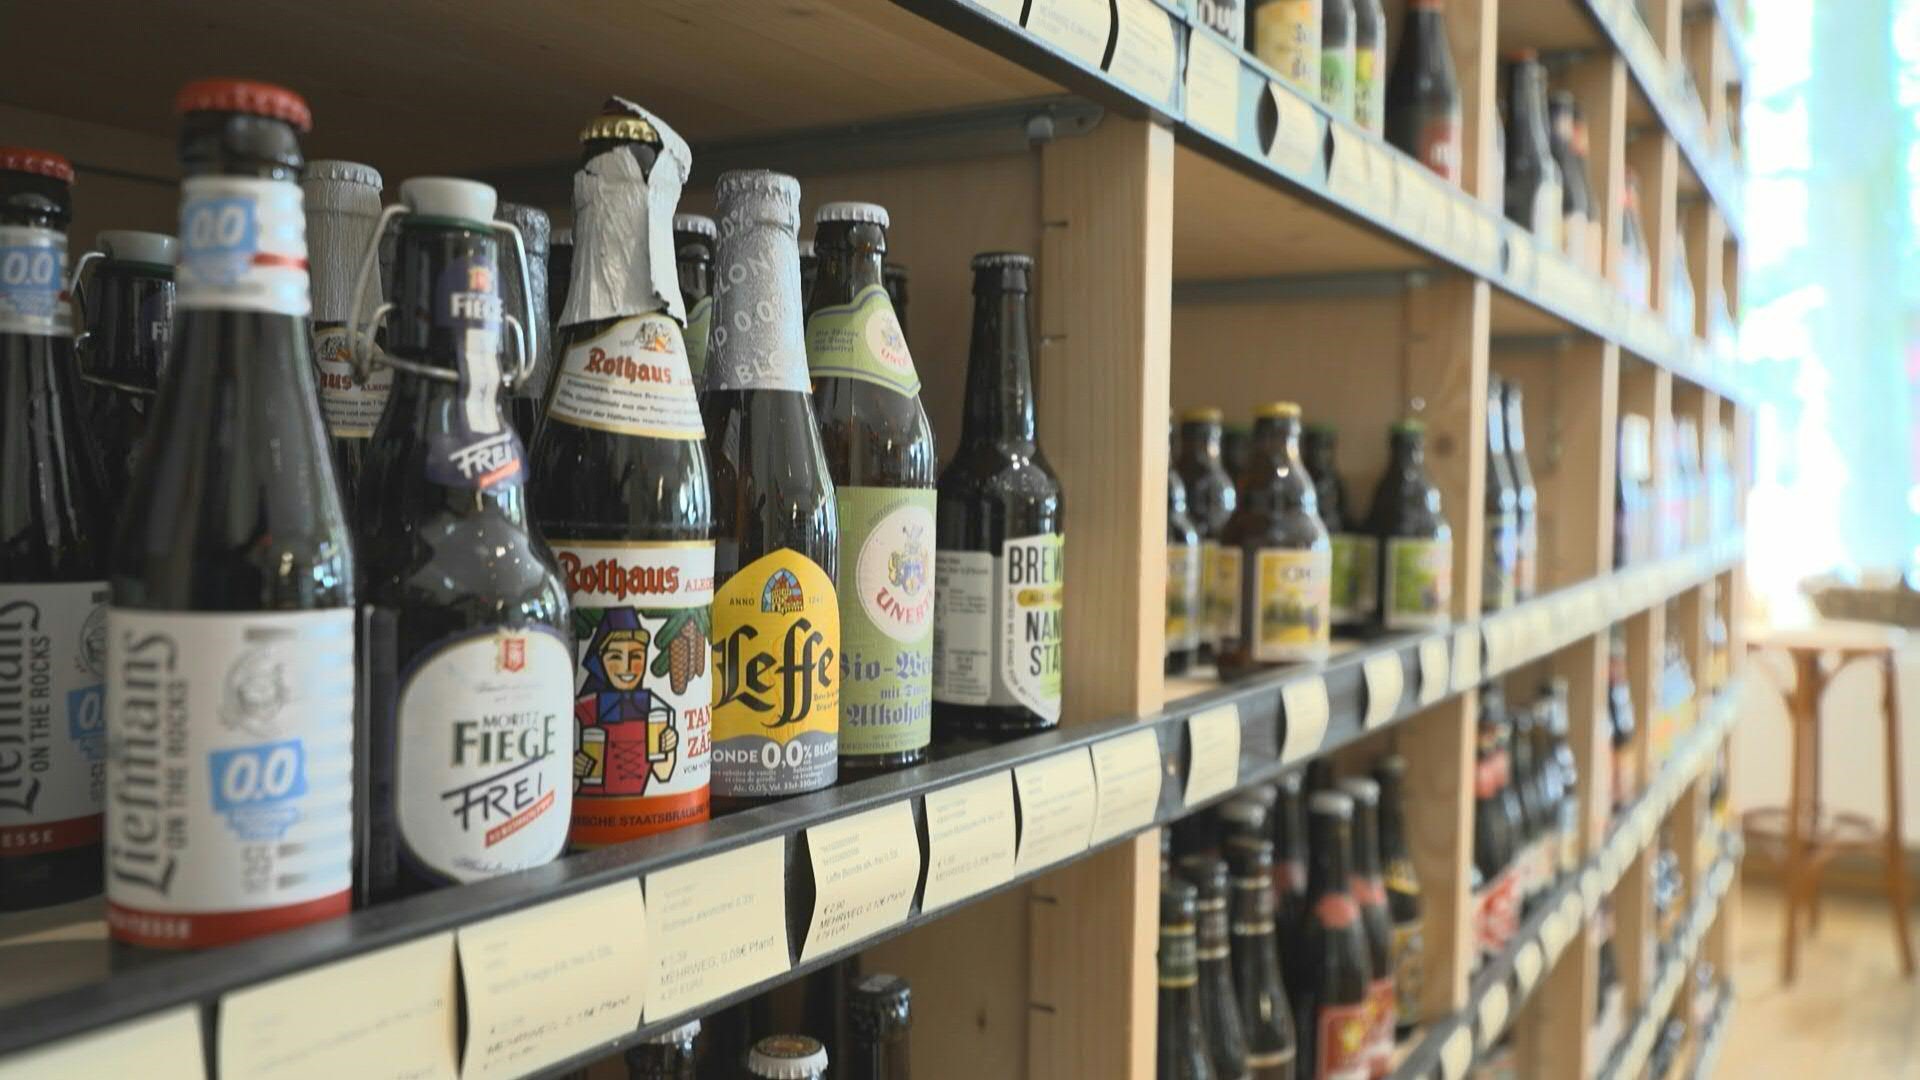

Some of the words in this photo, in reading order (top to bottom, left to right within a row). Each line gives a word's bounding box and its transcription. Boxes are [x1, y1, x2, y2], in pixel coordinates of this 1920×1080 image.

[584, 346, 672, 385] Rothaus
[448, 434, 514, 480] FREI
[559, 551, 680, 602] Rothaus
[729, 598, 755, 607] ANNO
[30, 636, 50, 698] ROCKS
[712, 617, 834, 729] Leffe
[30, 701, 50, 742] THE
[451, 714, 557, 768] FIEGE
[483, 711, 540, 730] MORITZ
[30, 744, 50, 773] ON
[113, 629, 178, 897] Liefmans
[223, 746, 298, 802] 0.0
[761, 740, 812, 769] 0,0%
[441, 766, 545, 832] FREI
[748, 935, 774, 953] Pfand
